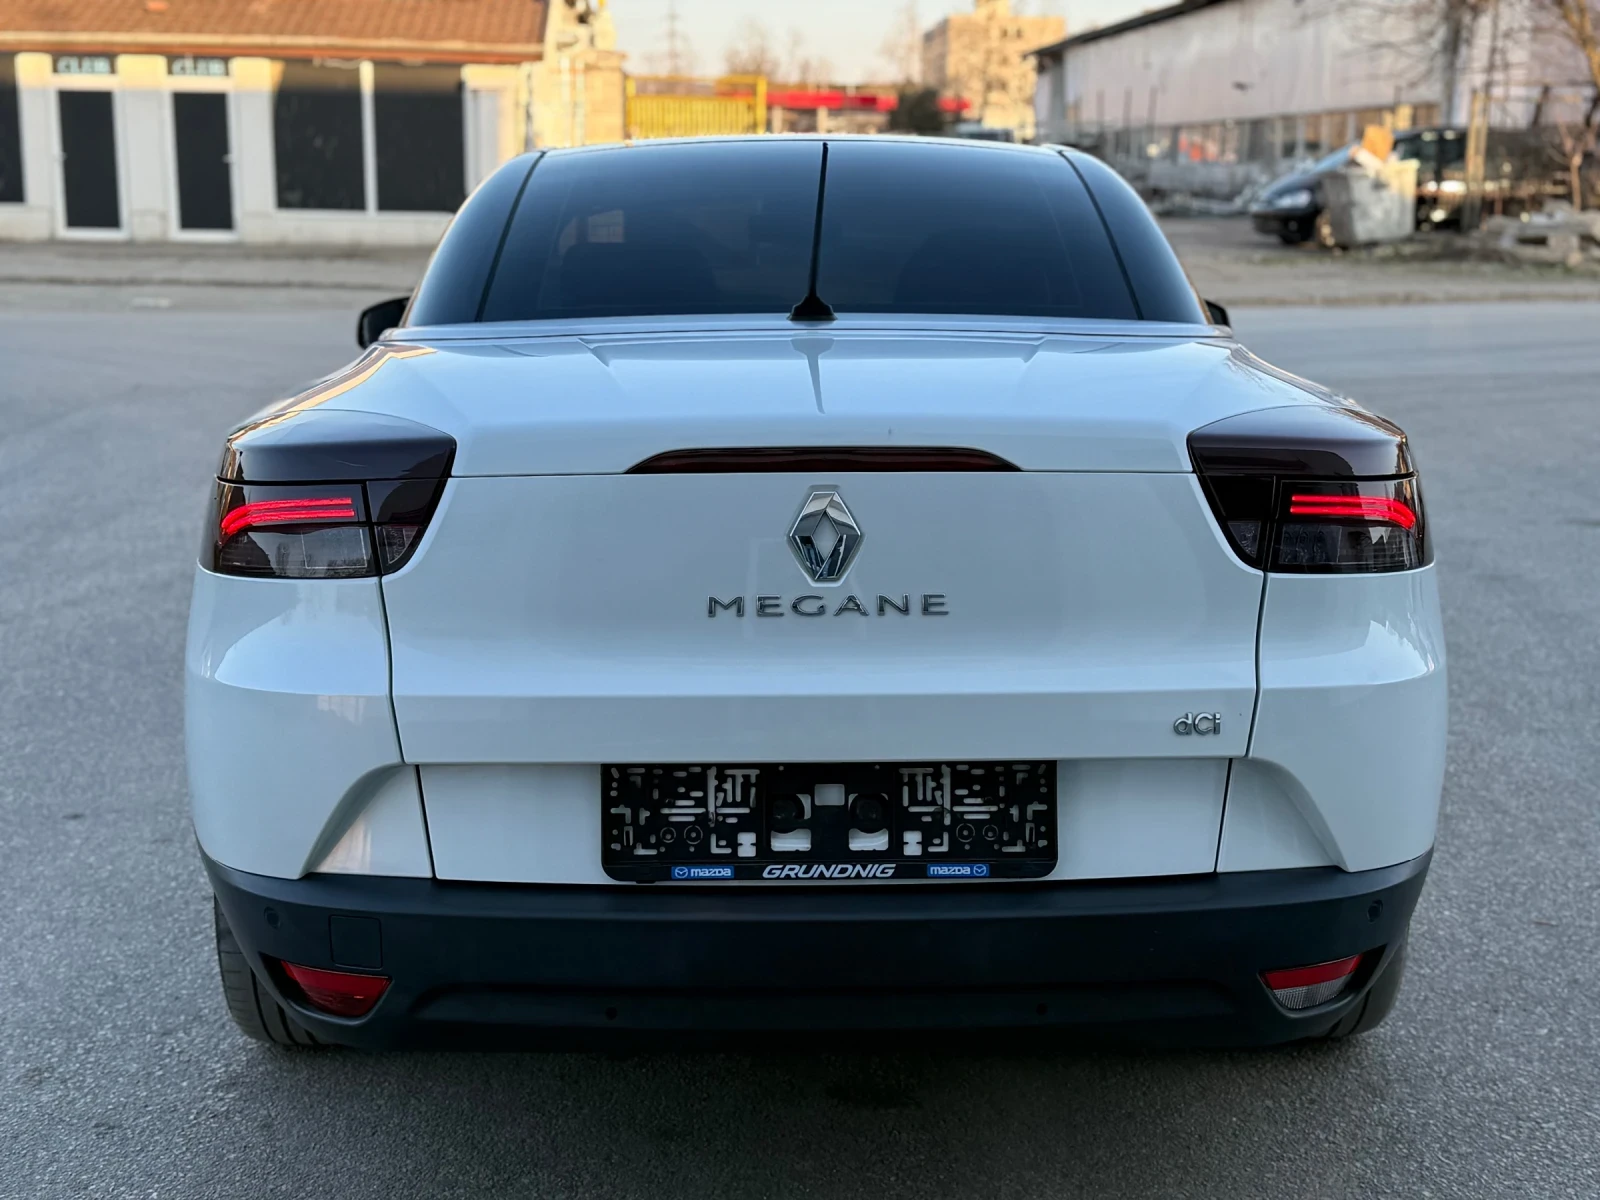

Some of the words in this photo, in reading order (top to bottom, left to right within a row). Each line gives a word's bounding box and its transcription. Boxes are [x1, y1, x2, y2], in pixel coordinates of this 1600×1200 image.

[707, 593, 949, 617] MEGANE
[1173, 712, 1221, 735] dCi
[690, 867, 732, 877] mazda
[762, 863, 896, 878] GRUNDNIG
[930, 866, 971, 875] mazda
